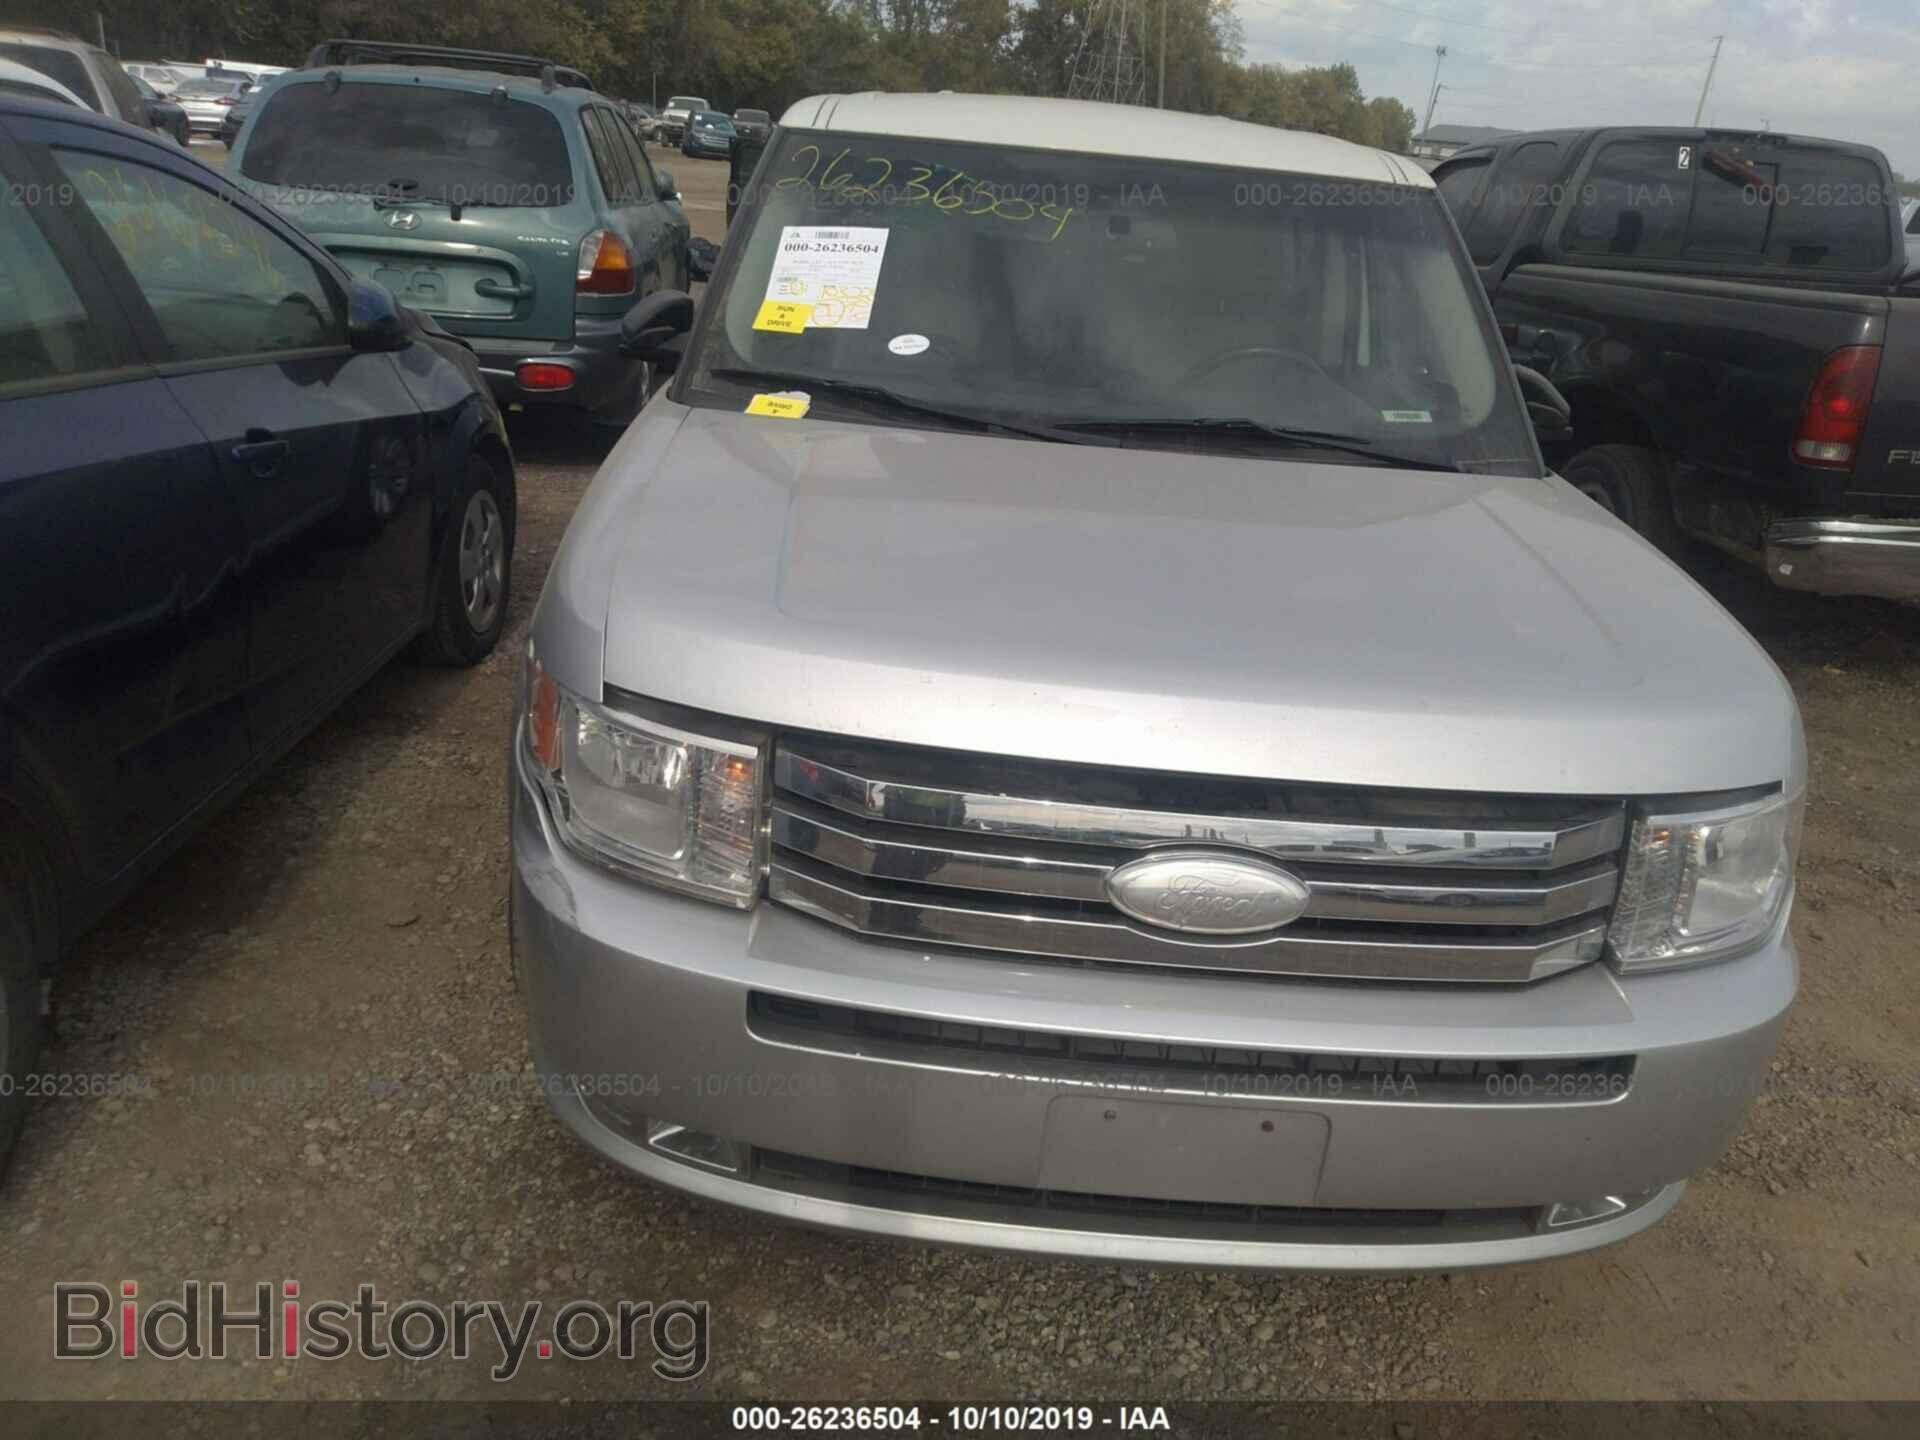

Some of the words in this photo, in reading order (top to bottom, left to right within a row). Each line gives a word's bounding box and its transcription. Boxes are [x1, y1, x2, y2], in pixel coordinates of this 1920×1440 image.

[1680, 148, 1689, 168] 2
[775, 145, 1072, 240] 26236504
[784, 242, 879, 253] 000-26236504
[1157, 875, 1264, 923] Ford
